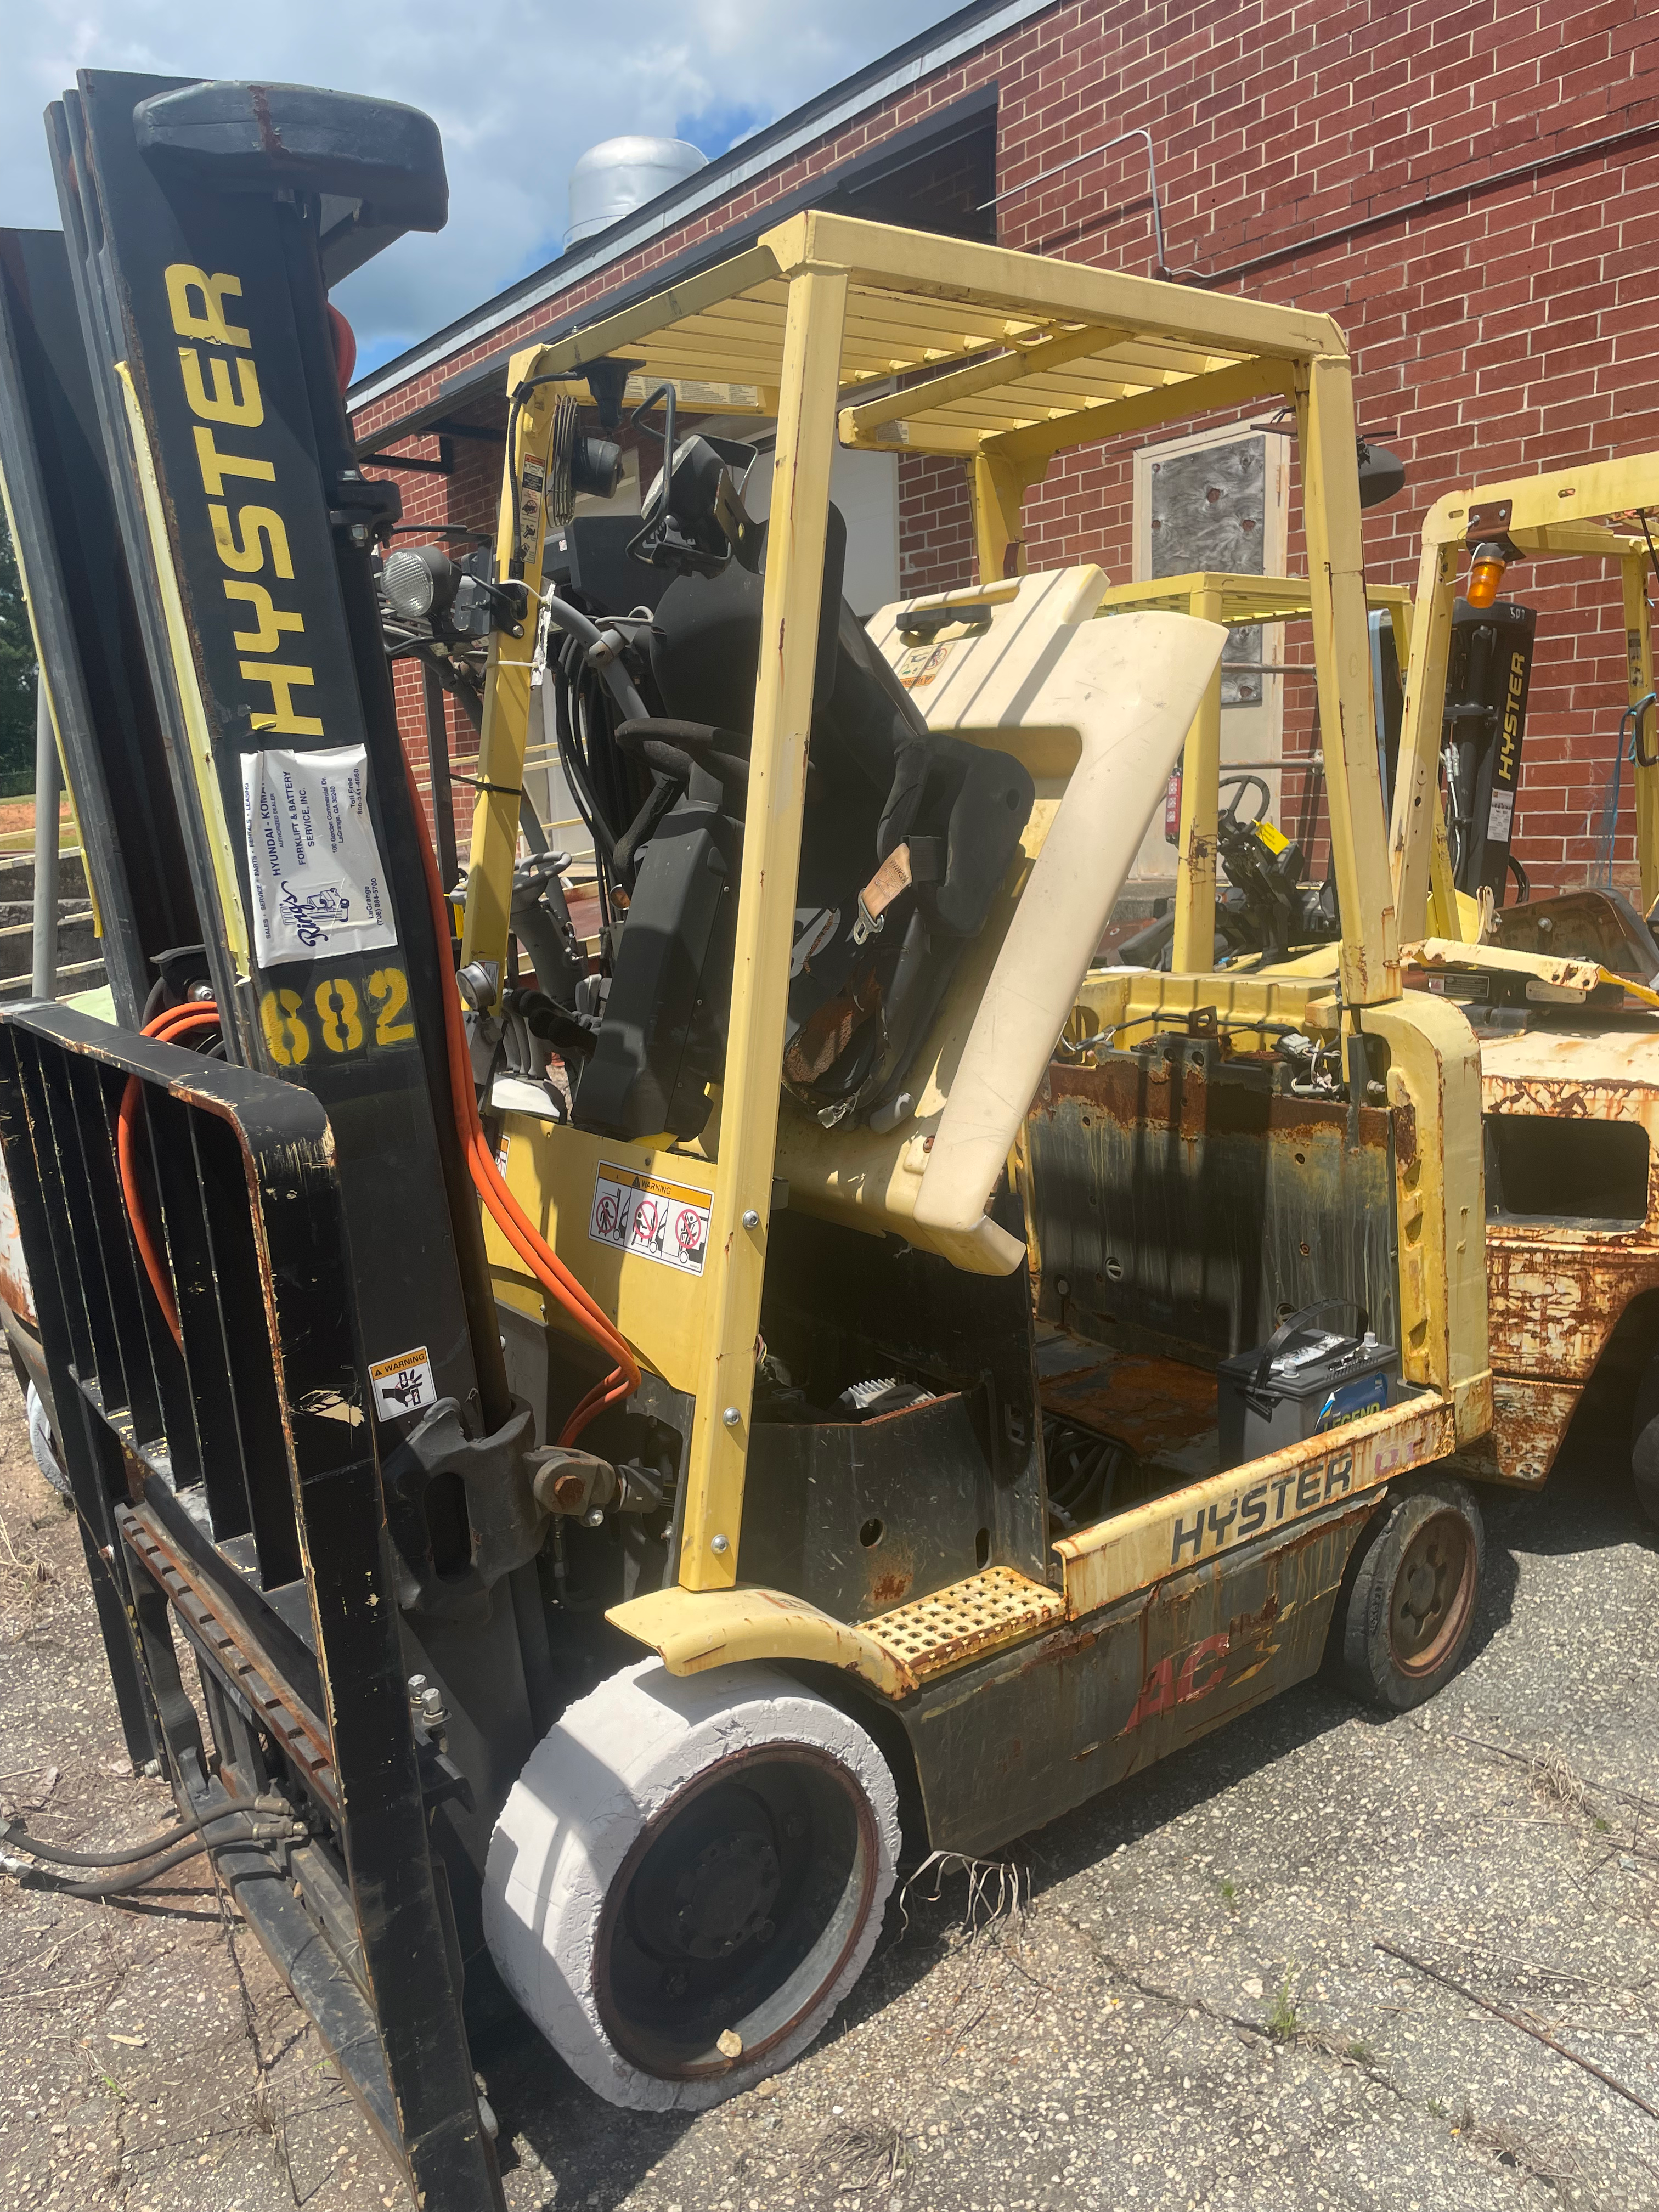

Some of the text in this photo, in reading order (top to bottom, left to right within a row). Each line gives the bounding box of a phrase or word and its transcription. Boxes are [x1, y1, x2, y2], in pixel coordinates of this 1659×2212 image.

[165, 263, 324, 736] HYSTER
[1498, 651, 1525, 781] HYSTER
[283, 771, 296, 811] BATTERY
[322, 787, 332, 820] Commercial
[333, 804, 339, 813] GA
[274, 816, 284, 848] AUTHORIZED
[299, 788, 314, 847] SERVICE, INC.
[264, 829, 281, 876] HYUNDAI
[292, 823, 306, 865] FORKLIFT
[365, 886, 374, 919] LaGrange
[371, 878, 381, 907] 884-5700
[279, 881, 329, 946] Ring's
[261, 967, 414, 1066] 682
[641, 1180, 671, 1195] WARNING
[384, 1353, 425, 1373] WARNING
[1171, 1452, 1352, 1565] HYSTER
